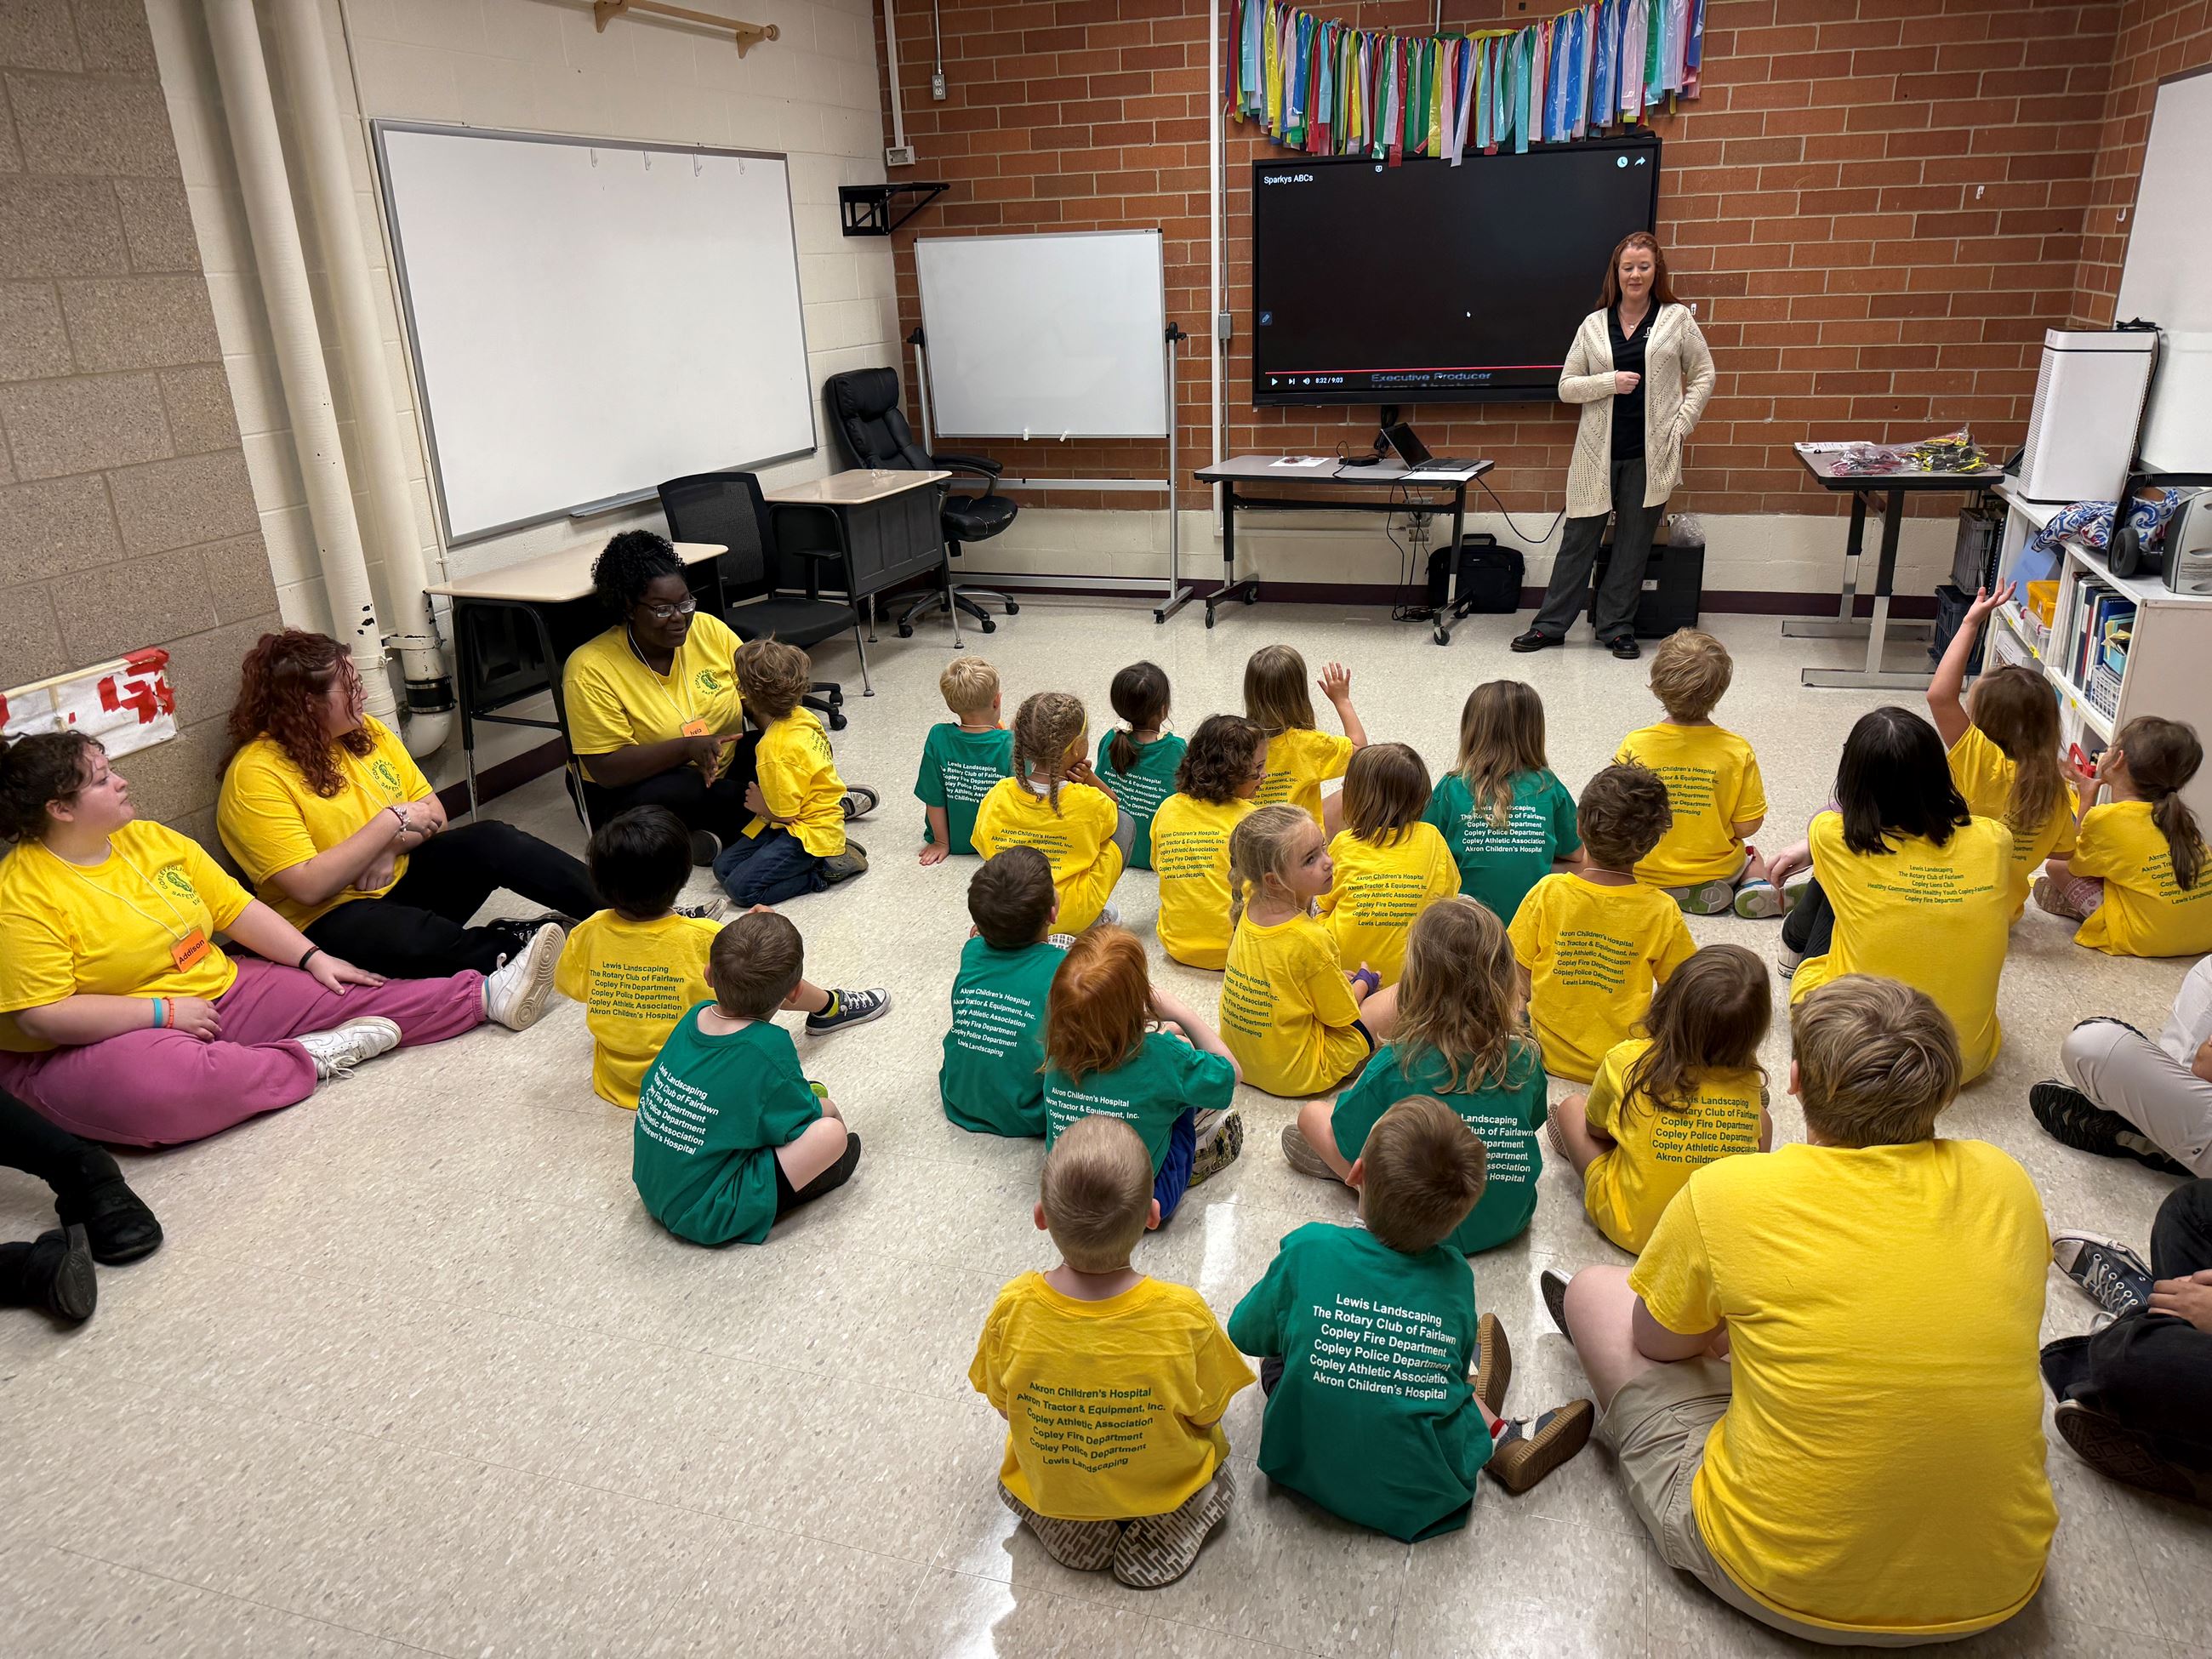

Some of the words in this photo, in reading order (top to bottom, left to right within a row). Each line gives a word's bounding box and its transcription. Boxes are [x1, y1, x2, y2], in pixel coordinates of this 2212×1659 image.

[1264, 175, 1291, 185] Sparkys
[1909, 872, 1925, 881] Rotary
[1867, 882, 1886, 891] Healthy
[1888, 885, 1921, 894] Communities
[1958, 884, 1993, 895] Copley-Fairlawn
[1905, 895, 1922, 904] Copley
[1577, 931, 1606, 941] Children's
[1607, 936, 1633, 948] Hospital
[180, 939, 204, 964] Addison
[603, 961, 621, 970] Lewis
[624, 964, 669, 973] Landscaping
[1597, 953, 1631, 966] Association
[602, 971, 624, 980] Rotary
[592, 989, 613, 998] Copley
[596, 980, 618, 989] Copley
[633, 983, 676, 992] Department
[590, 998, 611, 1006] Copley
[613, 1000, 635, 1008] Athletic
[976, 989, 1003, 999] Children's
[1005, 995, 1030, 1006] Hospital
[613, 1009, 643, 1018] Children's
[646, 1011, 678, 1020] Hospital
[989, 1001, 1023, 1016] Equipment,
[1024, 1012, 1036, 1020] Inc.
[989, 1013, 1026, 1028] Association
[983, 1023, 1017, 1037] Department
[983, 1035, 1018, 1047] Department
[969, 1042, 1004, 1057] Landscaping
[667, 1073, 708, 1100] Landscaping
[664, 1085, 676, 1097] Club
[685, 1097, 719, 1115] Fairlawn
[1067, 1091, 1098, 1103] Children's
[1100, 1097, 1129, 1108] Hospital
[1702, 1096, 1748, 1109] Landscaping
[654, 1092, 663, 1103] Fire
[664, 1099, 706, 1123] Department
[1058, 1101, 1078, 1111] Tractor
[1086, 1107, 1125, 1119] Equipment,
[1705, 1108, 1725, 1116] Club
[1728, 1109, 1735, 1117] of
[1736, 1109, 1759, 1120] Fairlawn
[648, 1100, 661, 1116] Police
[662, 1111, 706, 1135] Department
[1462, 1114, 1518, 1126] Landscaping
[1662, 1117, 1693, 1128] Copley
[1696, 1119, 1713, 1127] Fire
[1716, 1120, 1753, 1131] Department
[659, 1123, 704, 1146] Association
[1500, 1128, 1533, 1137] Fairlawn
[1656, 1128, 1687, 1140] Copley
[1690, 1132, 1717, 1140] Police
[664, 1136, 696, 1155] Hospital
[1652, 1140, 1683, 1152] Copley
[1686, 1143, 1719, 1152] Athletic
[1656, 1152, 1682, 1162] Akron
[1490, 1173, 1525, 1183] Hospital
[1336, 1294, 1370, 1309] Lewis
[1373, 1302, 1442, 1327] Landscaping
[1313, 1306, 1331, 1318] The
[1335, 1309, 1373, 1328] Rotary
[1377, 1319, 1402, 1332] Club
[1406, 1325, 1418, 1335] of
[1420, 1328, 1456, 1345] Fairlawn
[1321, 1324, 1360, 1343] Copley
[1364, 1331, 1386, 1345] Fire
[1388, 1337, 1447, 1357] Department
[1314, 1339, 1352, 1358] Copley
[1355, 1347, 1389, 1361] Police
[1393, 1353, 1451, 1371] Department
[1310, 1354, 1346, 1373] Copley
[1348, 1363, 1391, 1378] Athletic
[1394, 1371, 1450, 1385] Associatio
[1029, 1382, 1054, 1395] Akron
[1058, 1387, 1106, 1398] Children's
[1110, 1388, 1151, 1400] Hospital
[1314, 1371, 1344, 1388] Akron
[1348, 1377, 1402, 1395] Children's
[1405, 1386, 1446, 1401] Hospital
[1017, 1394, 1040, 1406] Akron
[1043, 1400, 1075, 1412] Tractor
[1088, 1405, 1144, 1415] Equipment,
[1148, 1403, 1166, 1411] Inc.
[1028, 1408, 1054, 1426] Copley
[1057, 1418, 1092, 1429] Athletic
[1095, 1417, 1153, 1429] Association
[1034, 1427, 1063, 1440] Copley
[1068, 1432, 1084, 1442] Fire
[1086, 1432, 1143, 1445] Department
[1030, 1438, 1058, 1453] Copley
[1063, 1445, 1087, 1457] Police
[1091, 1444, 1146, 1459] Department
[1043, 1457, 1069, 1465] Lewis
[1073, 1457, 1128, 1473] Landscaping
